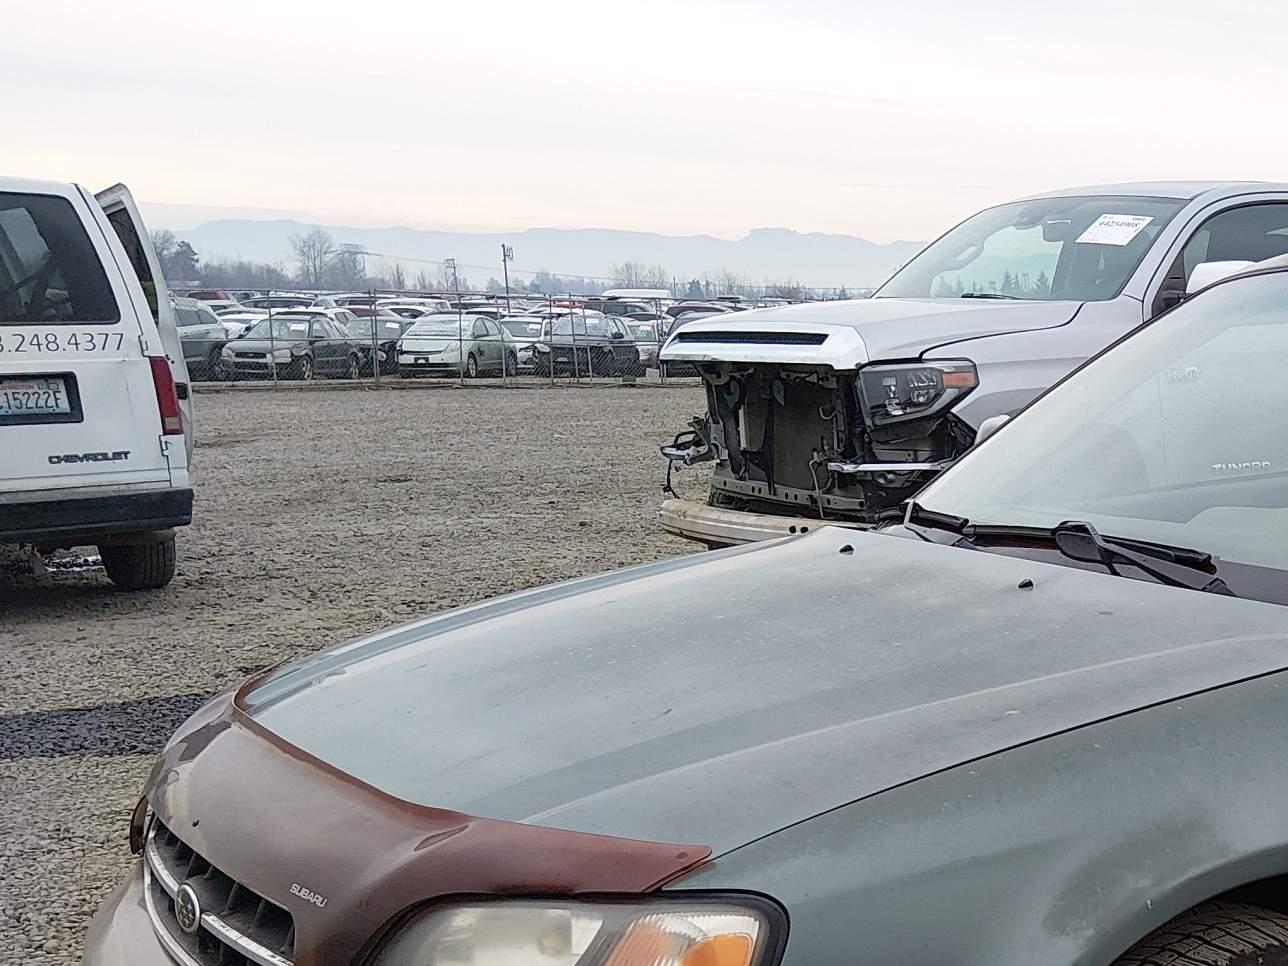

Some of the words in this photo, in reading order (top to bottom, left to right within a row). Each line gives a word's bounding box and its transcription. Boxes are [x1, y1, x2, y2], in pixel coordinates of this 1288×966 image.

[0, 333, 124, 353] .248.4377
[0, 391, 62, 410] 15222F
[48, 451, 131, 464] CHEVROLET
[290, 882, 328, 908] SUBARU
